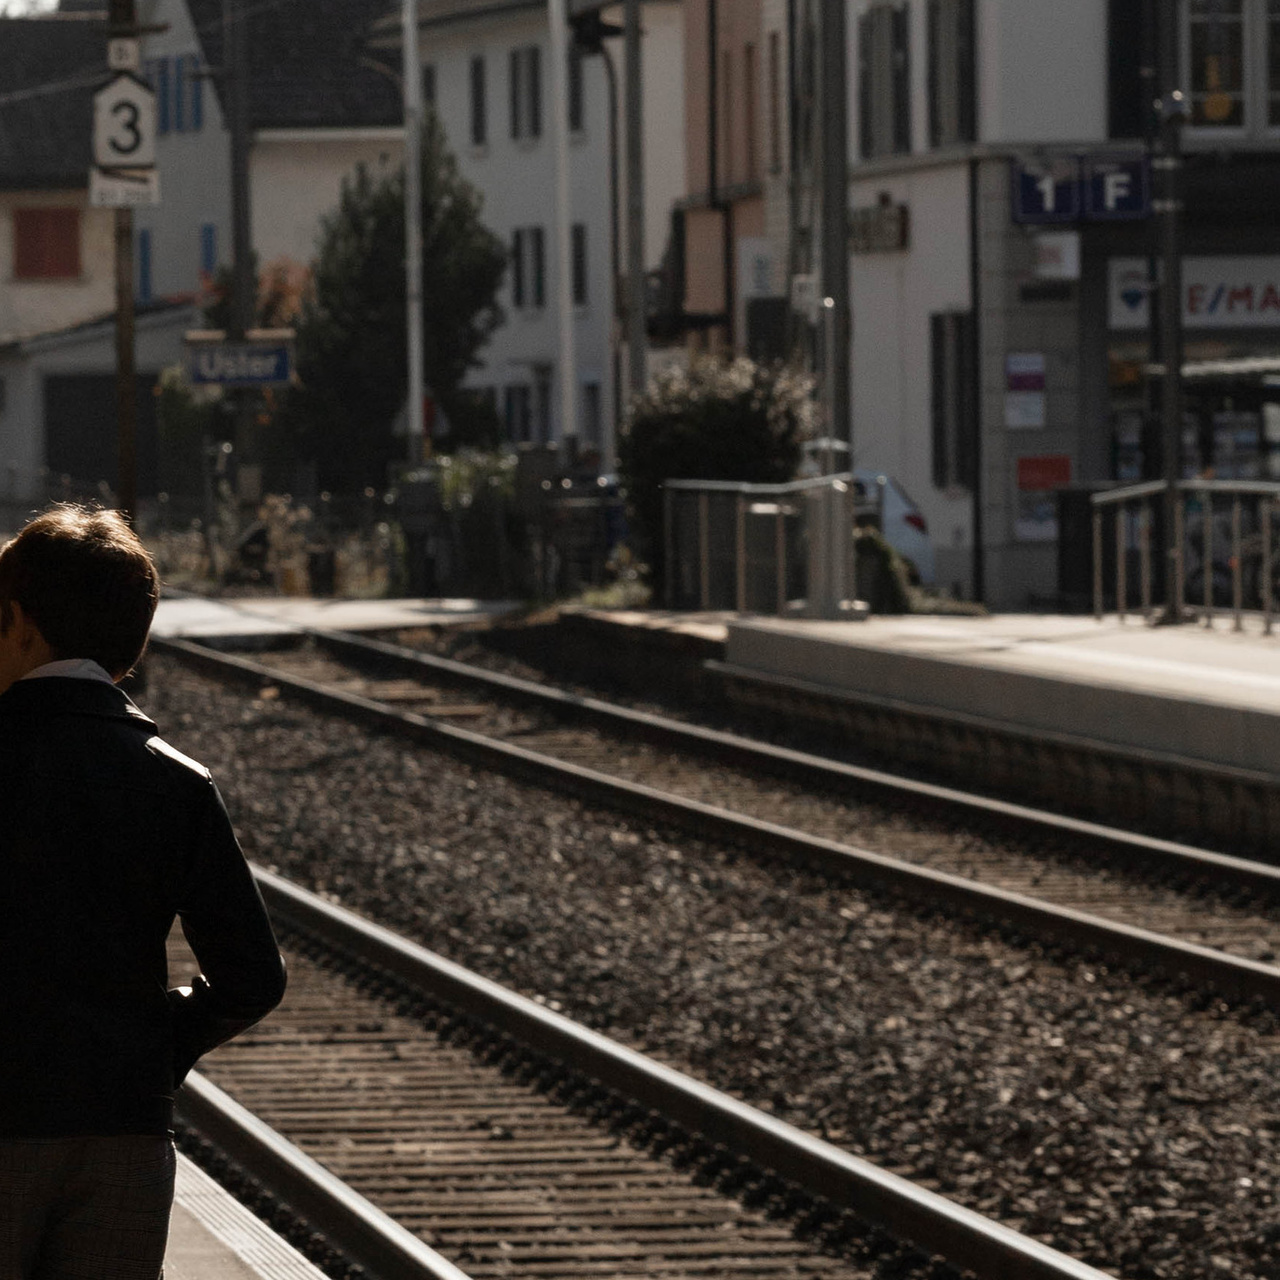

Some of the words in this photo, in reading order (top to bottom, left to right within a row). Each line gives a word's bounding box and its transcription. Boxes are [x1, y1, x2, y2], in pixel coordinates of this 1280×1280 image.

[108, 100, 143, 156] 3
[1036, 175, 1056, 212] 1
[1104, 172, 1131, 210] F
